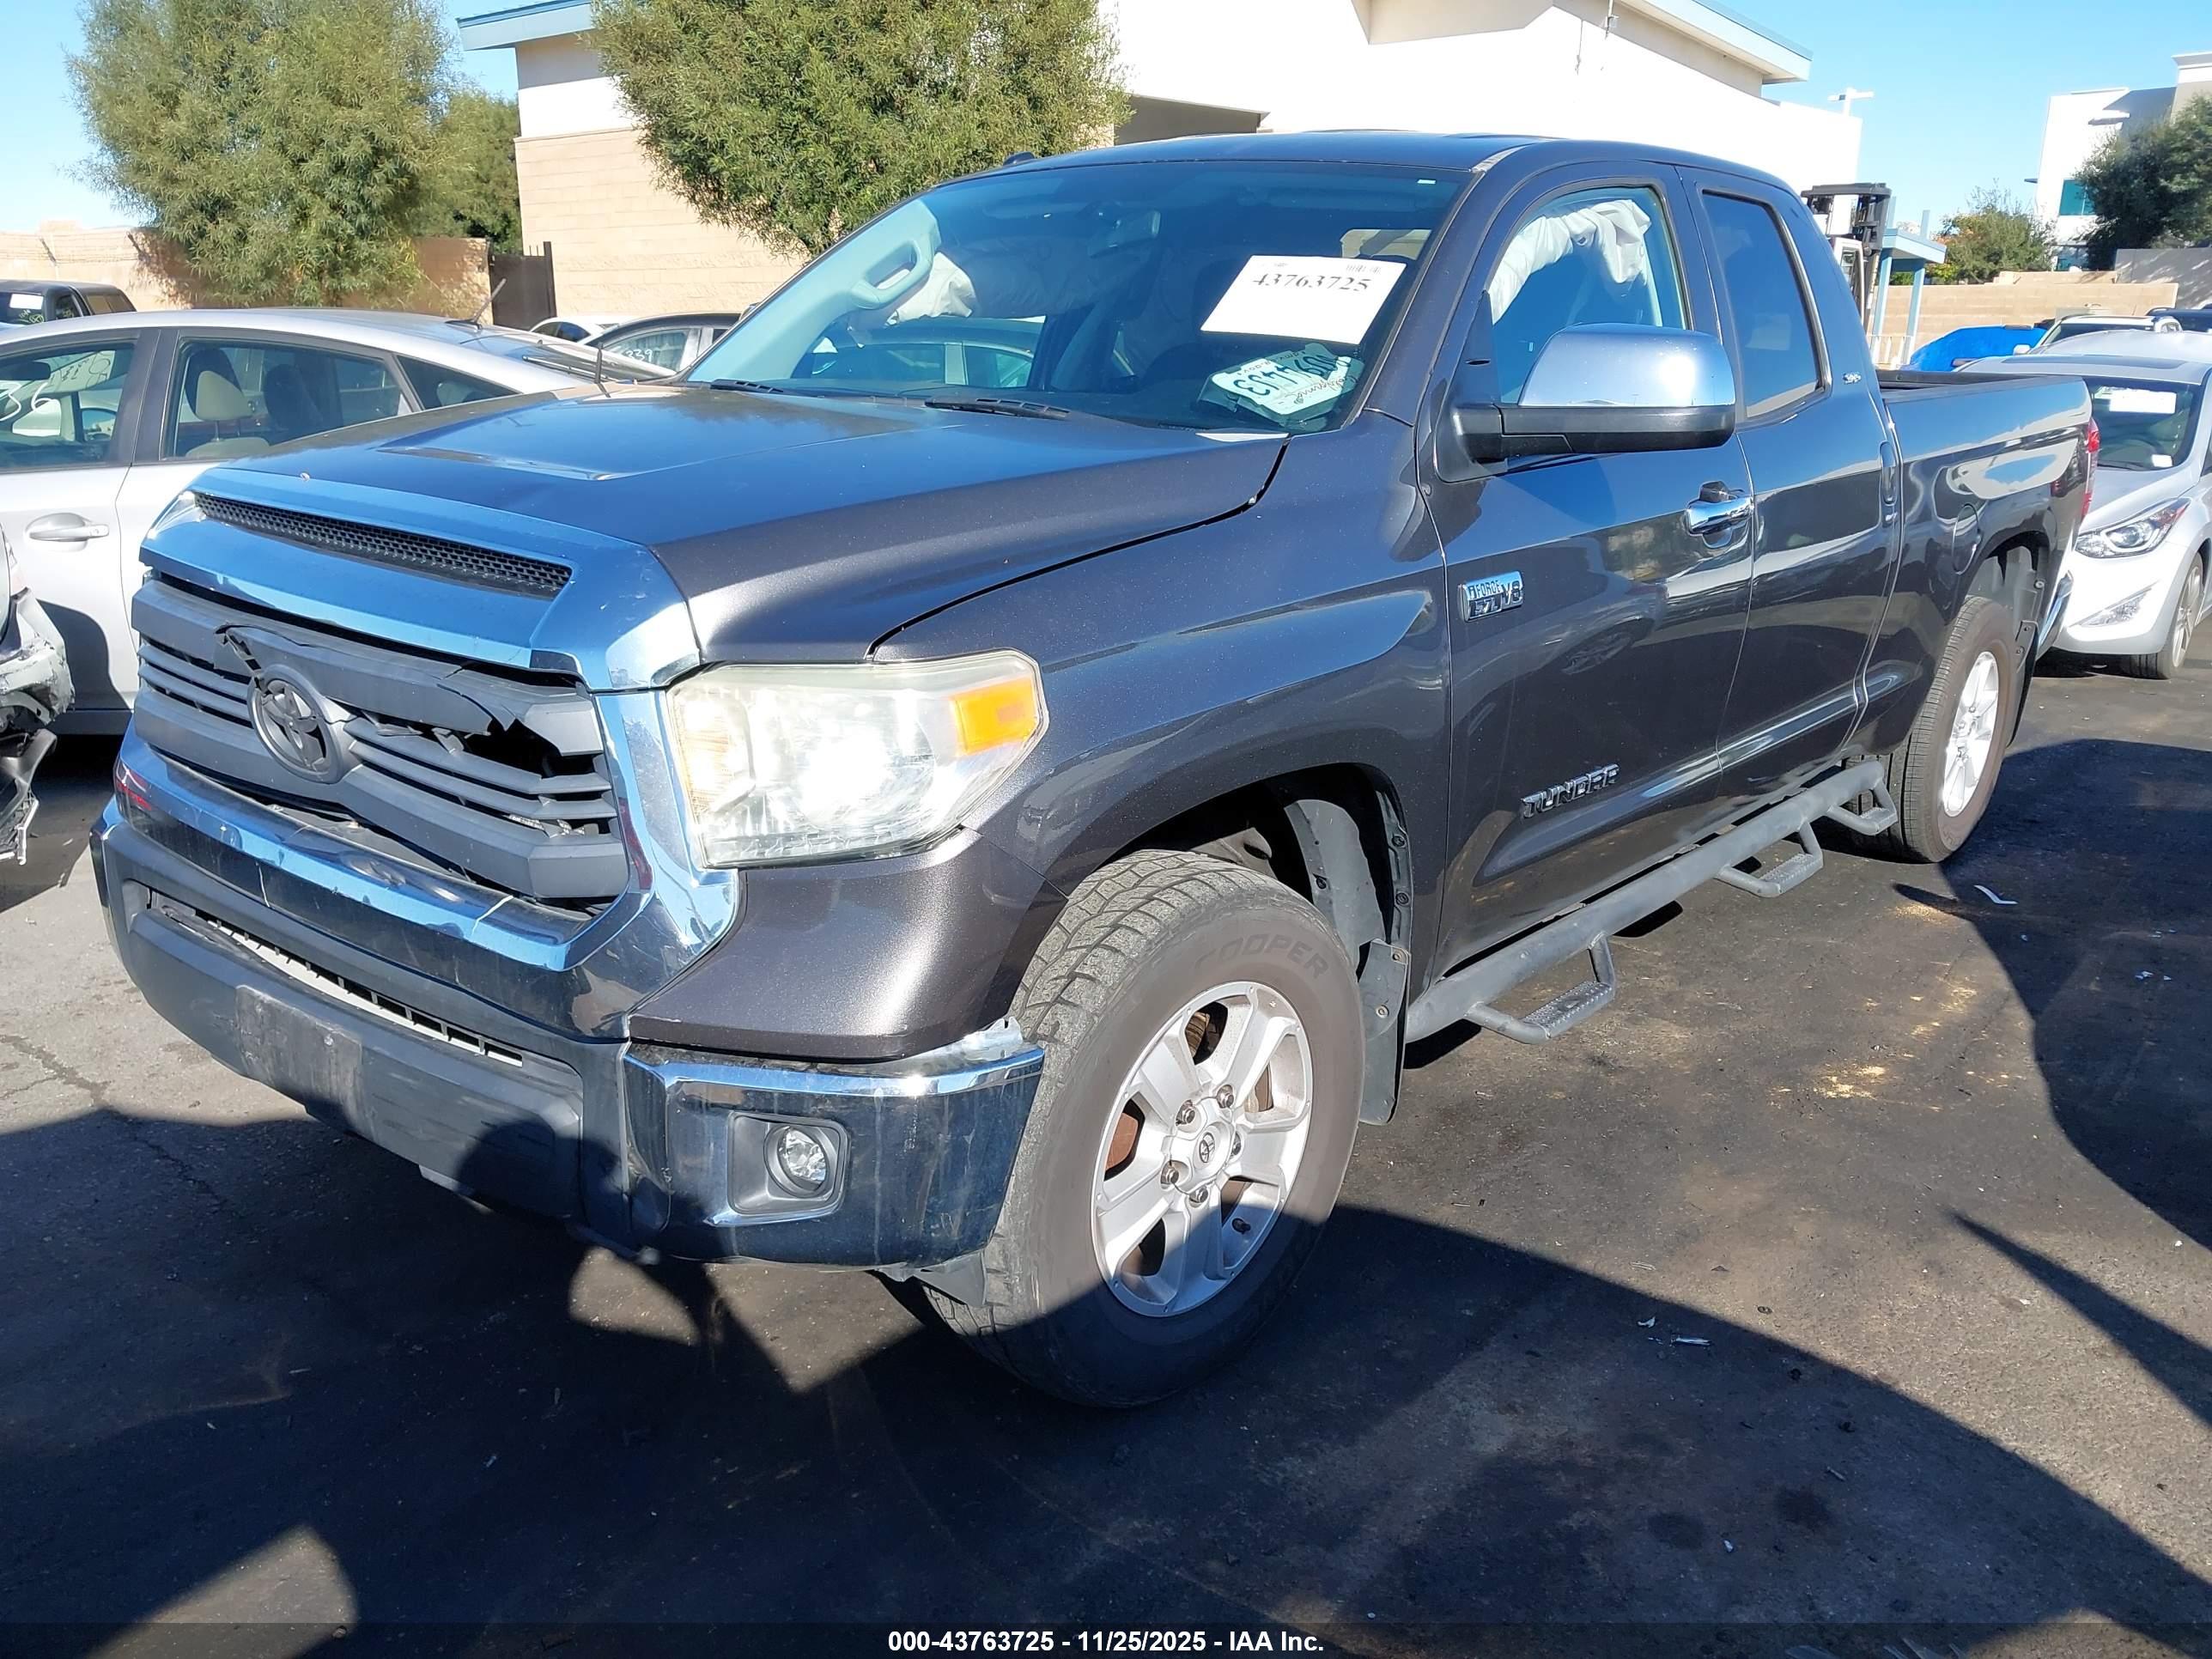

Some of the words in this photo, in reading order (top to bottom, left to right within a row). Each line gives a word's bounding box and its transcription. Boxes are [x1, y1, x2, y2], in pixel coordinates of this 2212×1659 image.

[1252, 272, 1371, 292] 43763725
[1500, 580, 1522, 605] V8
[1194, 933, 1329, 980] COOPER
